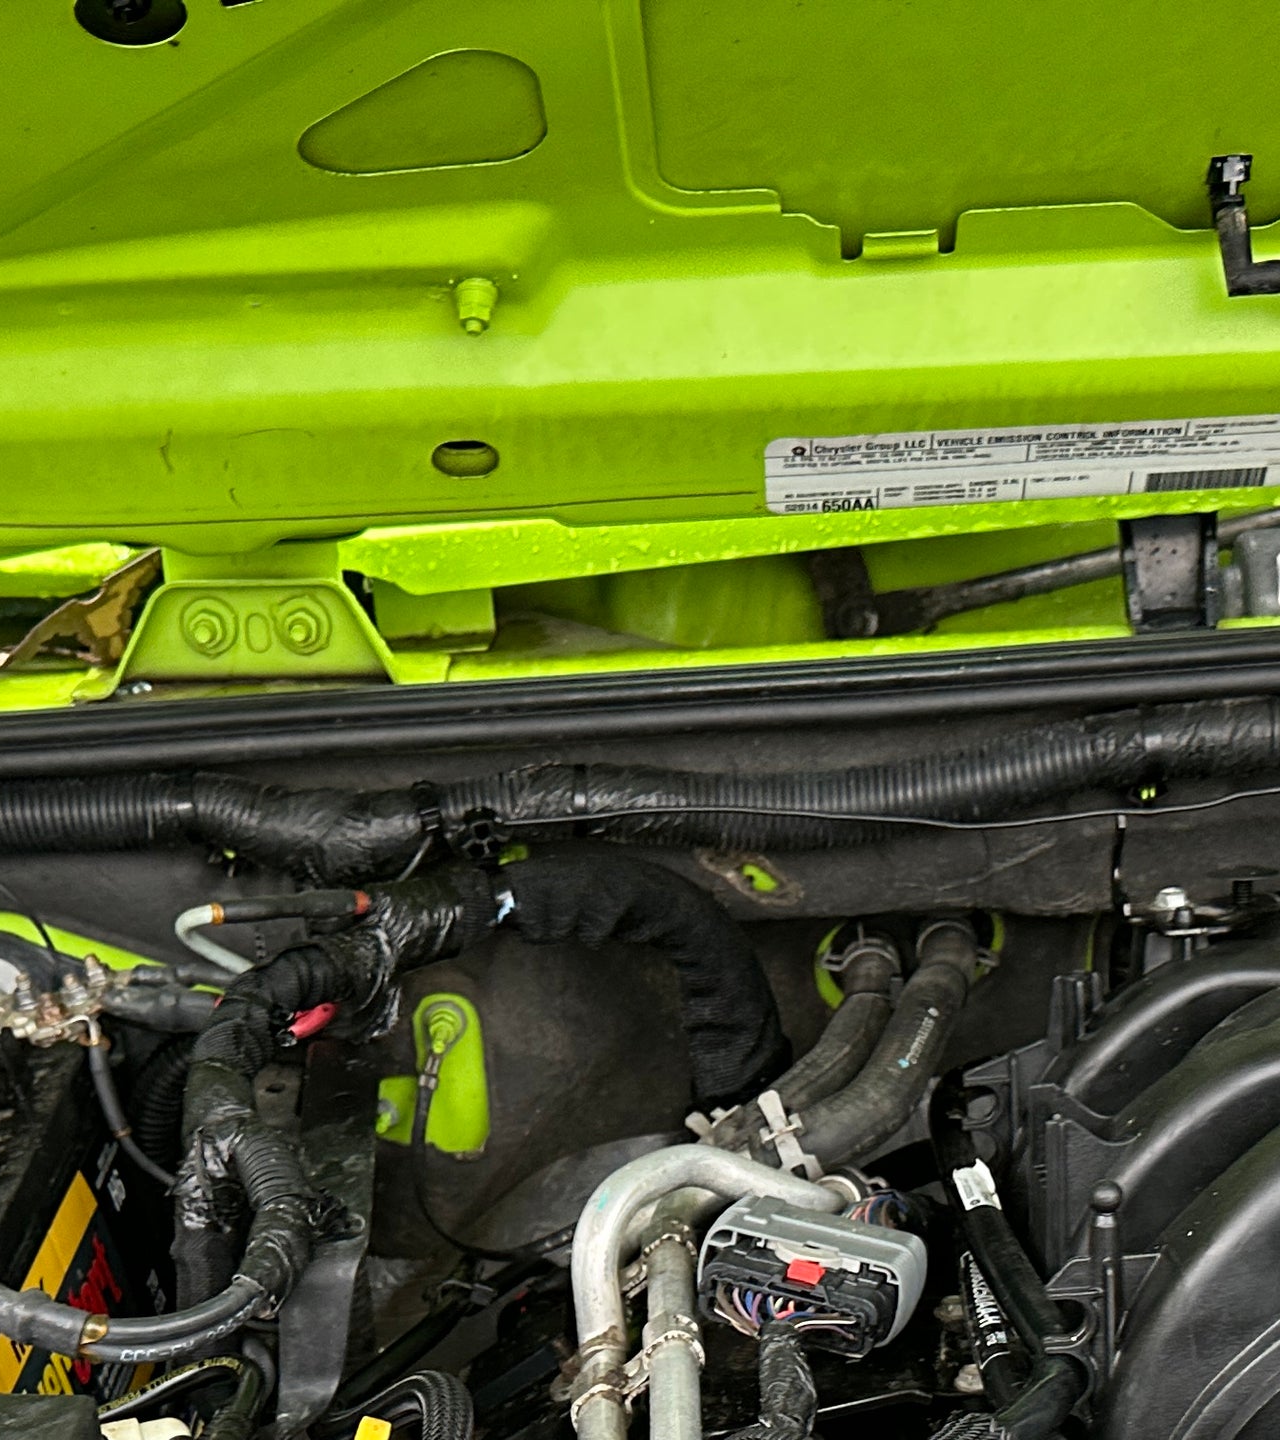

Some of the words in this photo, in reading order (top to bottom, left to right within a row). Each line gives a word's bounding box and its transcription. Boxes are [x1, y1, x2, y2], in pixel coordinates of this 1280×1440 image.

[936, 436, 984, 447] VEHICLE
[987, 433, 1043, 445] EMISSION
[1046, 430, 1099, 442] CONTROL
[1102, 426, 1183, 439] INFORMATION
[814, 444, 862, 456] Chrysler
[865, 441, 901, 453] Group
[904, 439, 926, 449] LLC
[822, 498, 875, 513] 650AA
